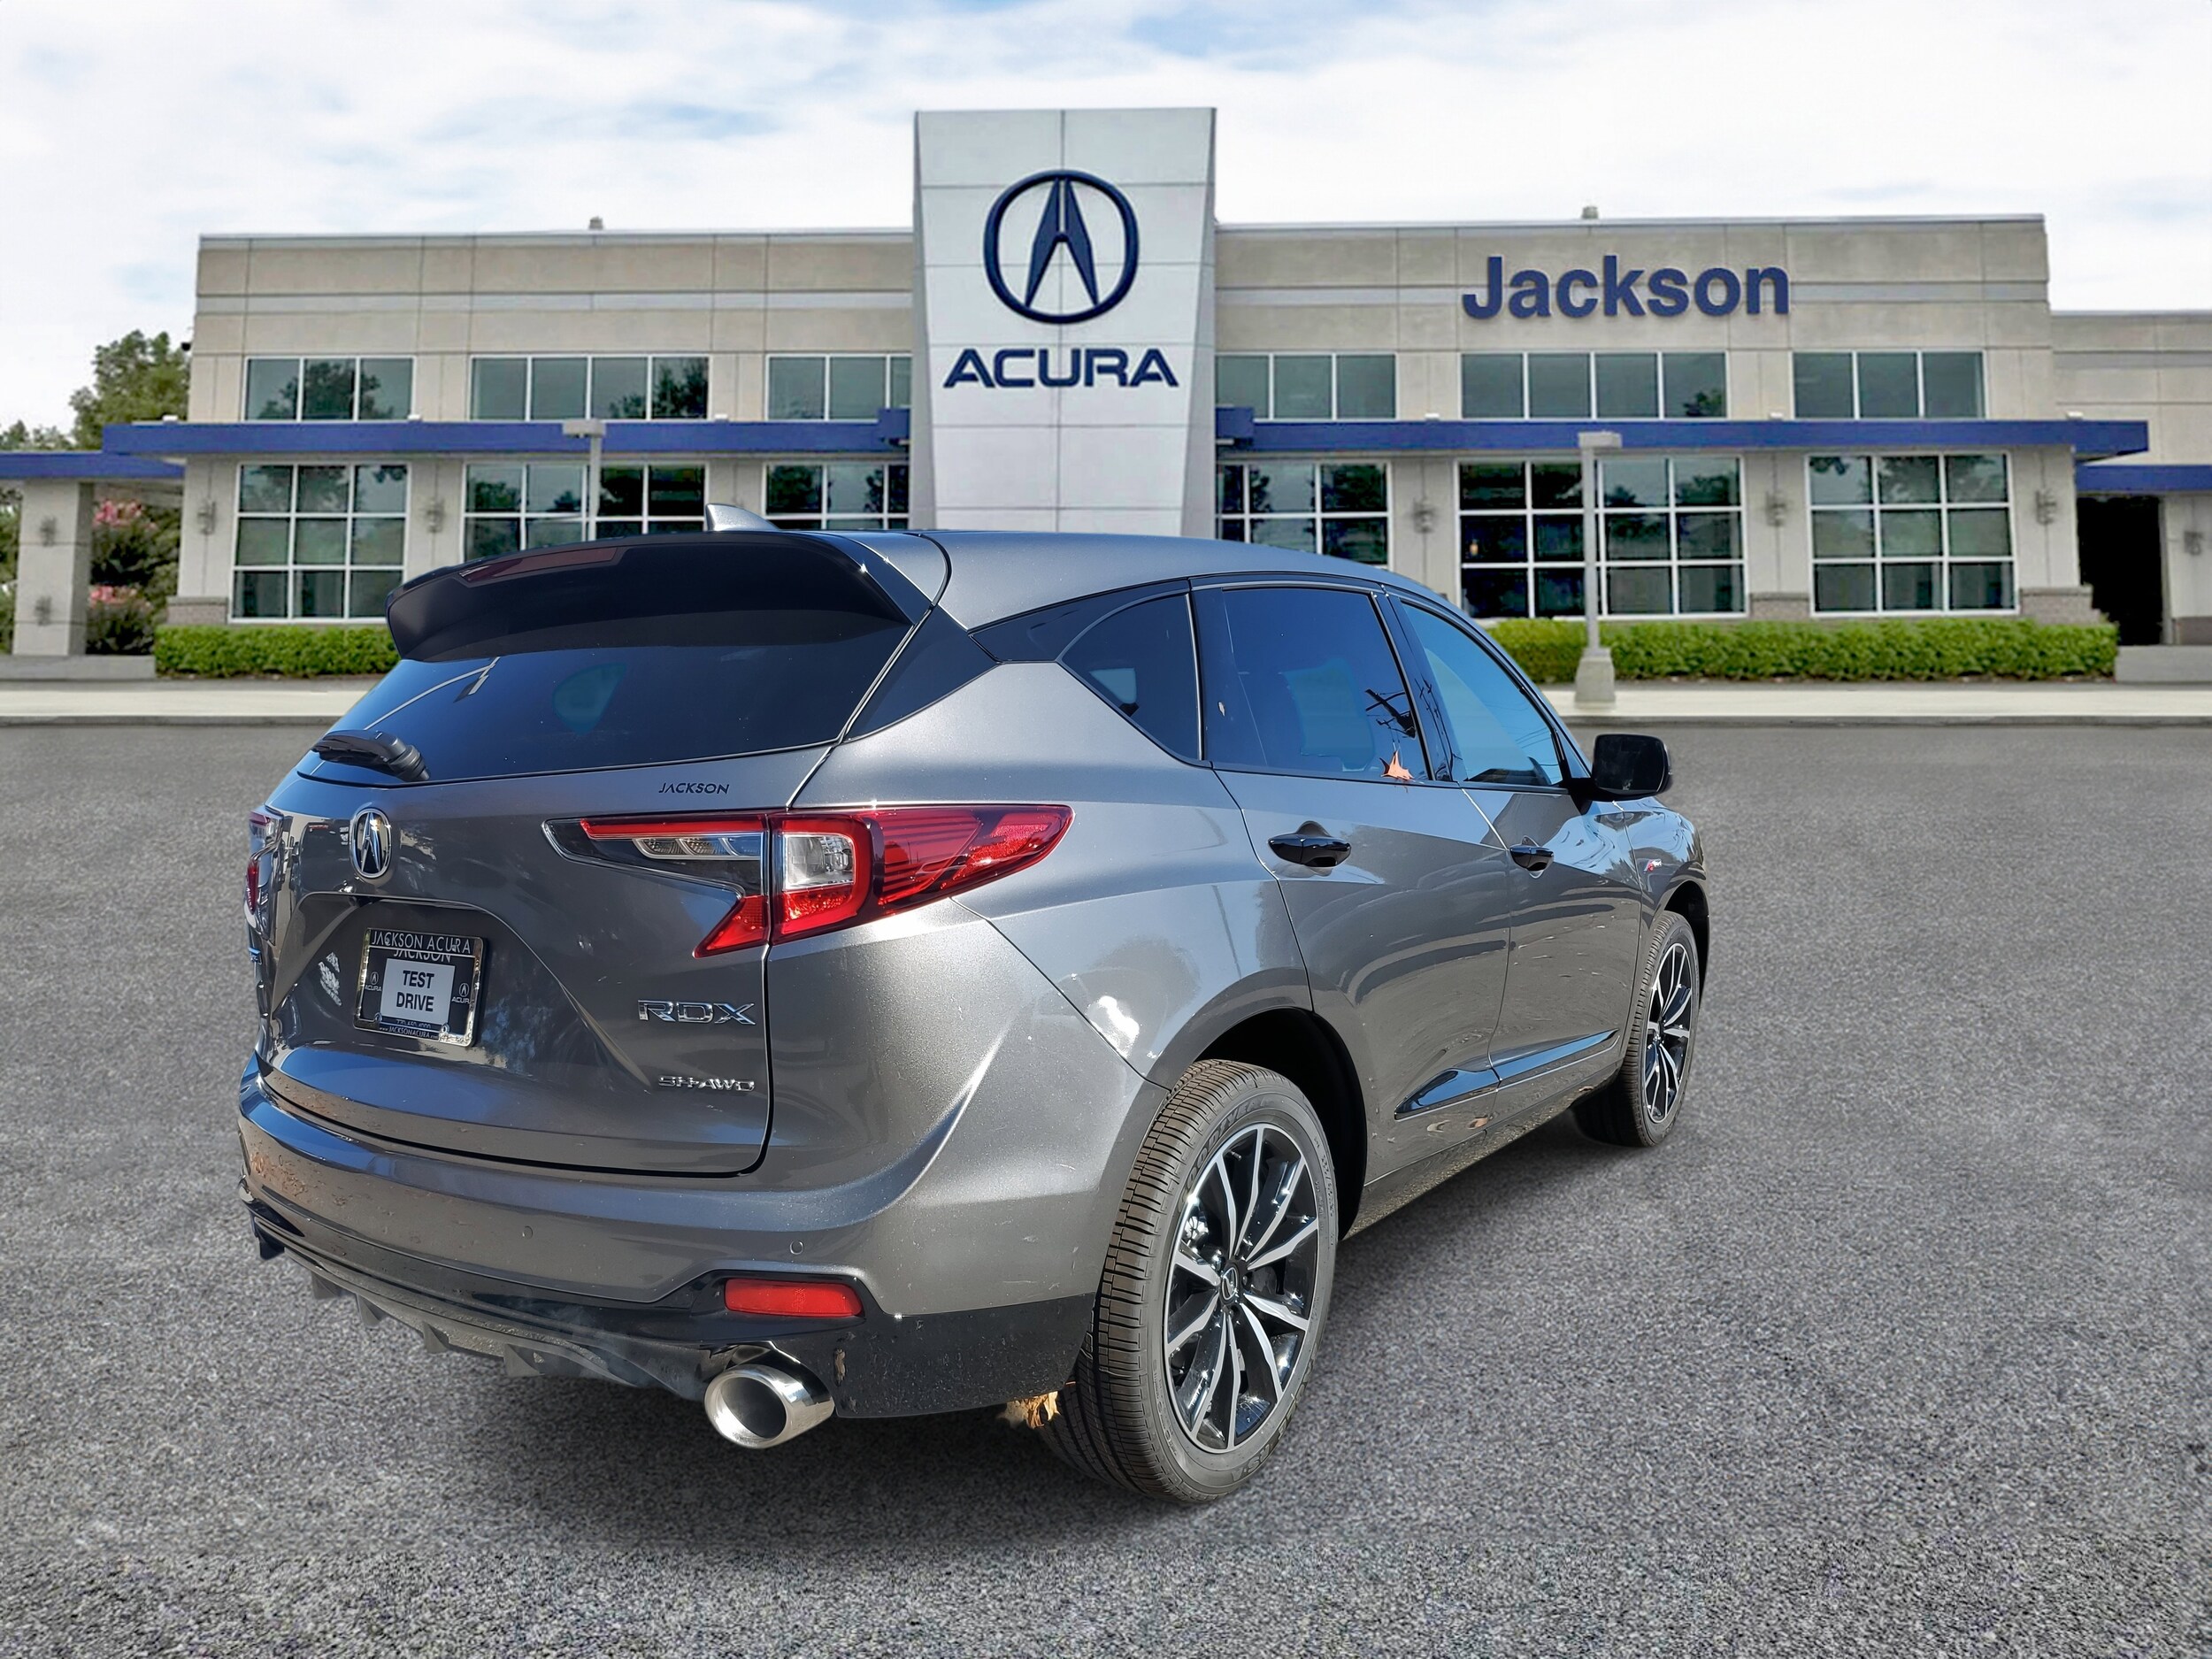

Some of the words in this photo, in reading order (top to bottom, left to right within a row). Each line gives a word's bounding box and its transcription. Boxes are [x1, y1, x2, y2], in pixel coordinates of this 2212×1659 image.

[1463, 255, 1790, 319] Jackson
[943, 348, 1179, 388] ACURA
[658, 782, 730, 795] JACKSON
[372, 931, 423, 949] JACKSON
[426, 936, 471, 954] ACURA
[403, 970, 434, 989] TEST
[396, 992, 434, 1011] DRIVE
[637, 999, 756, 1025] RDX
[658, 1075, 755, 1092] SH-AWD
